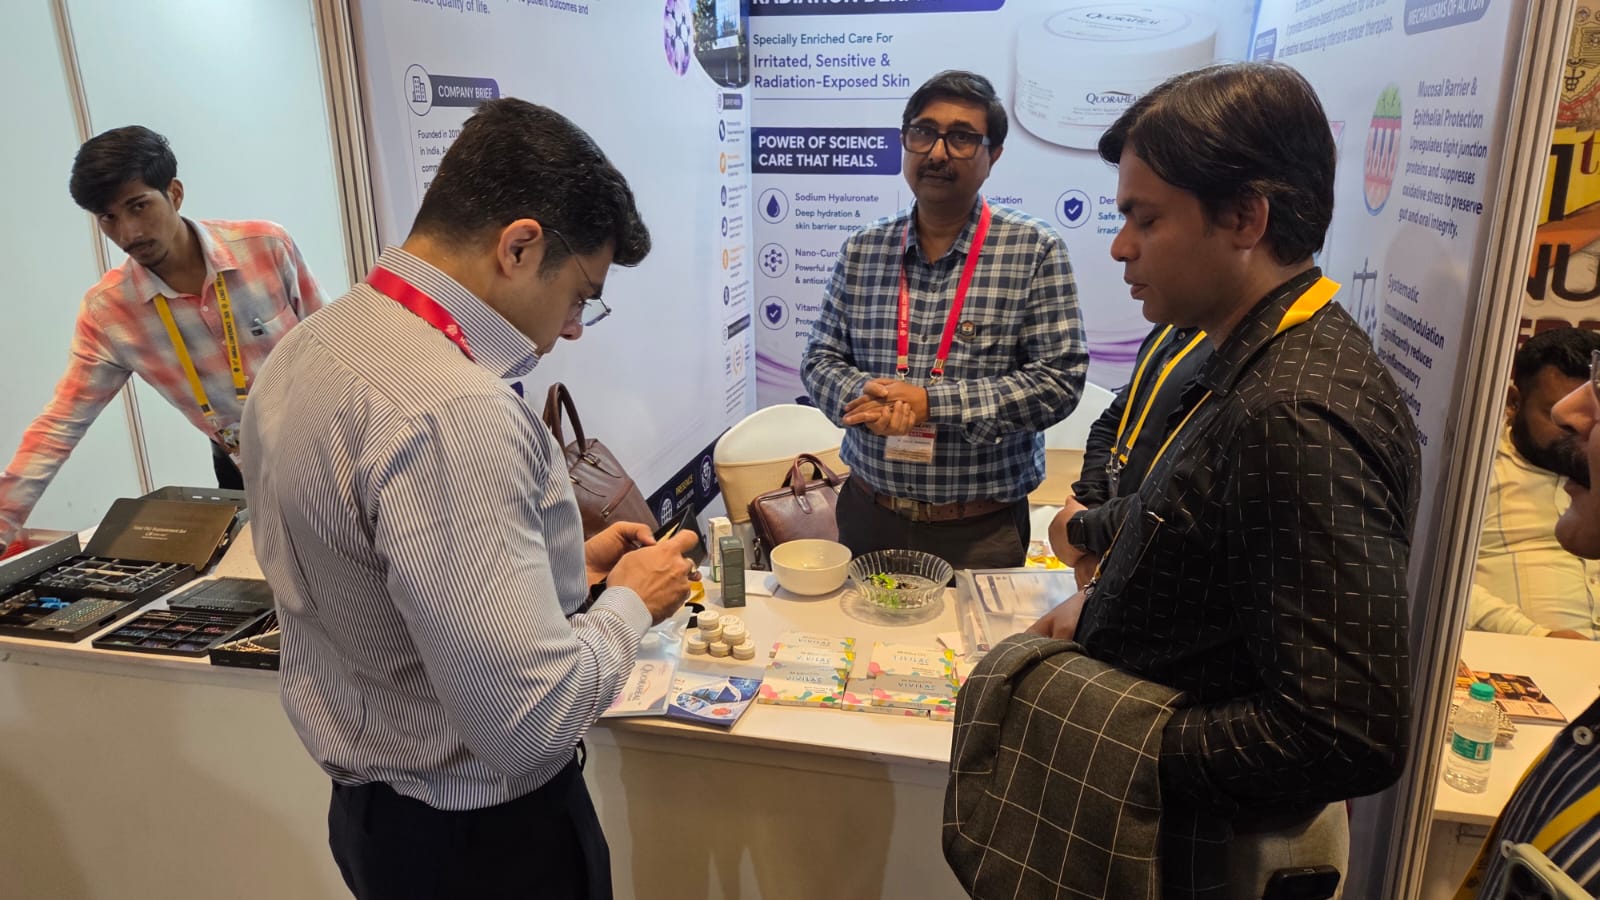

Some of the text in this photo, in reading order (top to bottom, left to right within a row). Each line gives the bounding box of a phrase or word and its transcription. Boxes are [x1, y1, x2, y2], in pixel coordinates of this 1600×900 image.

[578, 4, 589, 15] and
[752, 32, 893, 47] Specially Enriched Care For
[754, 53, 890, 69] Irritated, Sensitive &
[754, 73, 910, 91] Radiation-Exposed Skin
[1418, 76, 1478, 97] Mucosal Barrier &
[437, 85, 493, 99] COMPANY BRIEF
[1412, 108, 1484, 130] Epithelial Protection
[417, 129, 441, 139] Founded
[758, 135, 889, 149] POWER OF SCIENCE.
[1409, 136, 1442, 154] Upregulates
[1457, 140, 1488, 159] junction
[758, 154, 793, 167] CARE
[796, 154, 830, 167] THAT
[832, 154, 878, 168] HEALS.
[1405, 160, 1475, 185] proteins and suppresses
[795, 192, 879, 205] Sodium Hyaluronate
[1099, 195, 1116, 205] Der
[1426, 188, 1444, 206] stress
[1444, 192, 1451, 208] to
[1451, 196, 1484, 215] preserve
[795, 209, 861, 219] Deep hydration &
[1097, 211, 1117, 221] Safe
[795, 222, 810, 230] skin
[811, 222, 837, 231] barrier
[1097, 225, 1120, 234] irradi
[1407, 208, 1419, 223] and
[1418, 211, 1431, 228] oral
[1430, 214, 1458, 239] integrity.
[794, 248, 839, 258] Nano-Curc
[795, 264, 825, 272] Powerful
[795, 276, 801, 284] &
[1387, 272, 1420, 304] Systematic
[795, 303, 820, 311] Vitami
[1410, 344, 1433, 369] reduces
